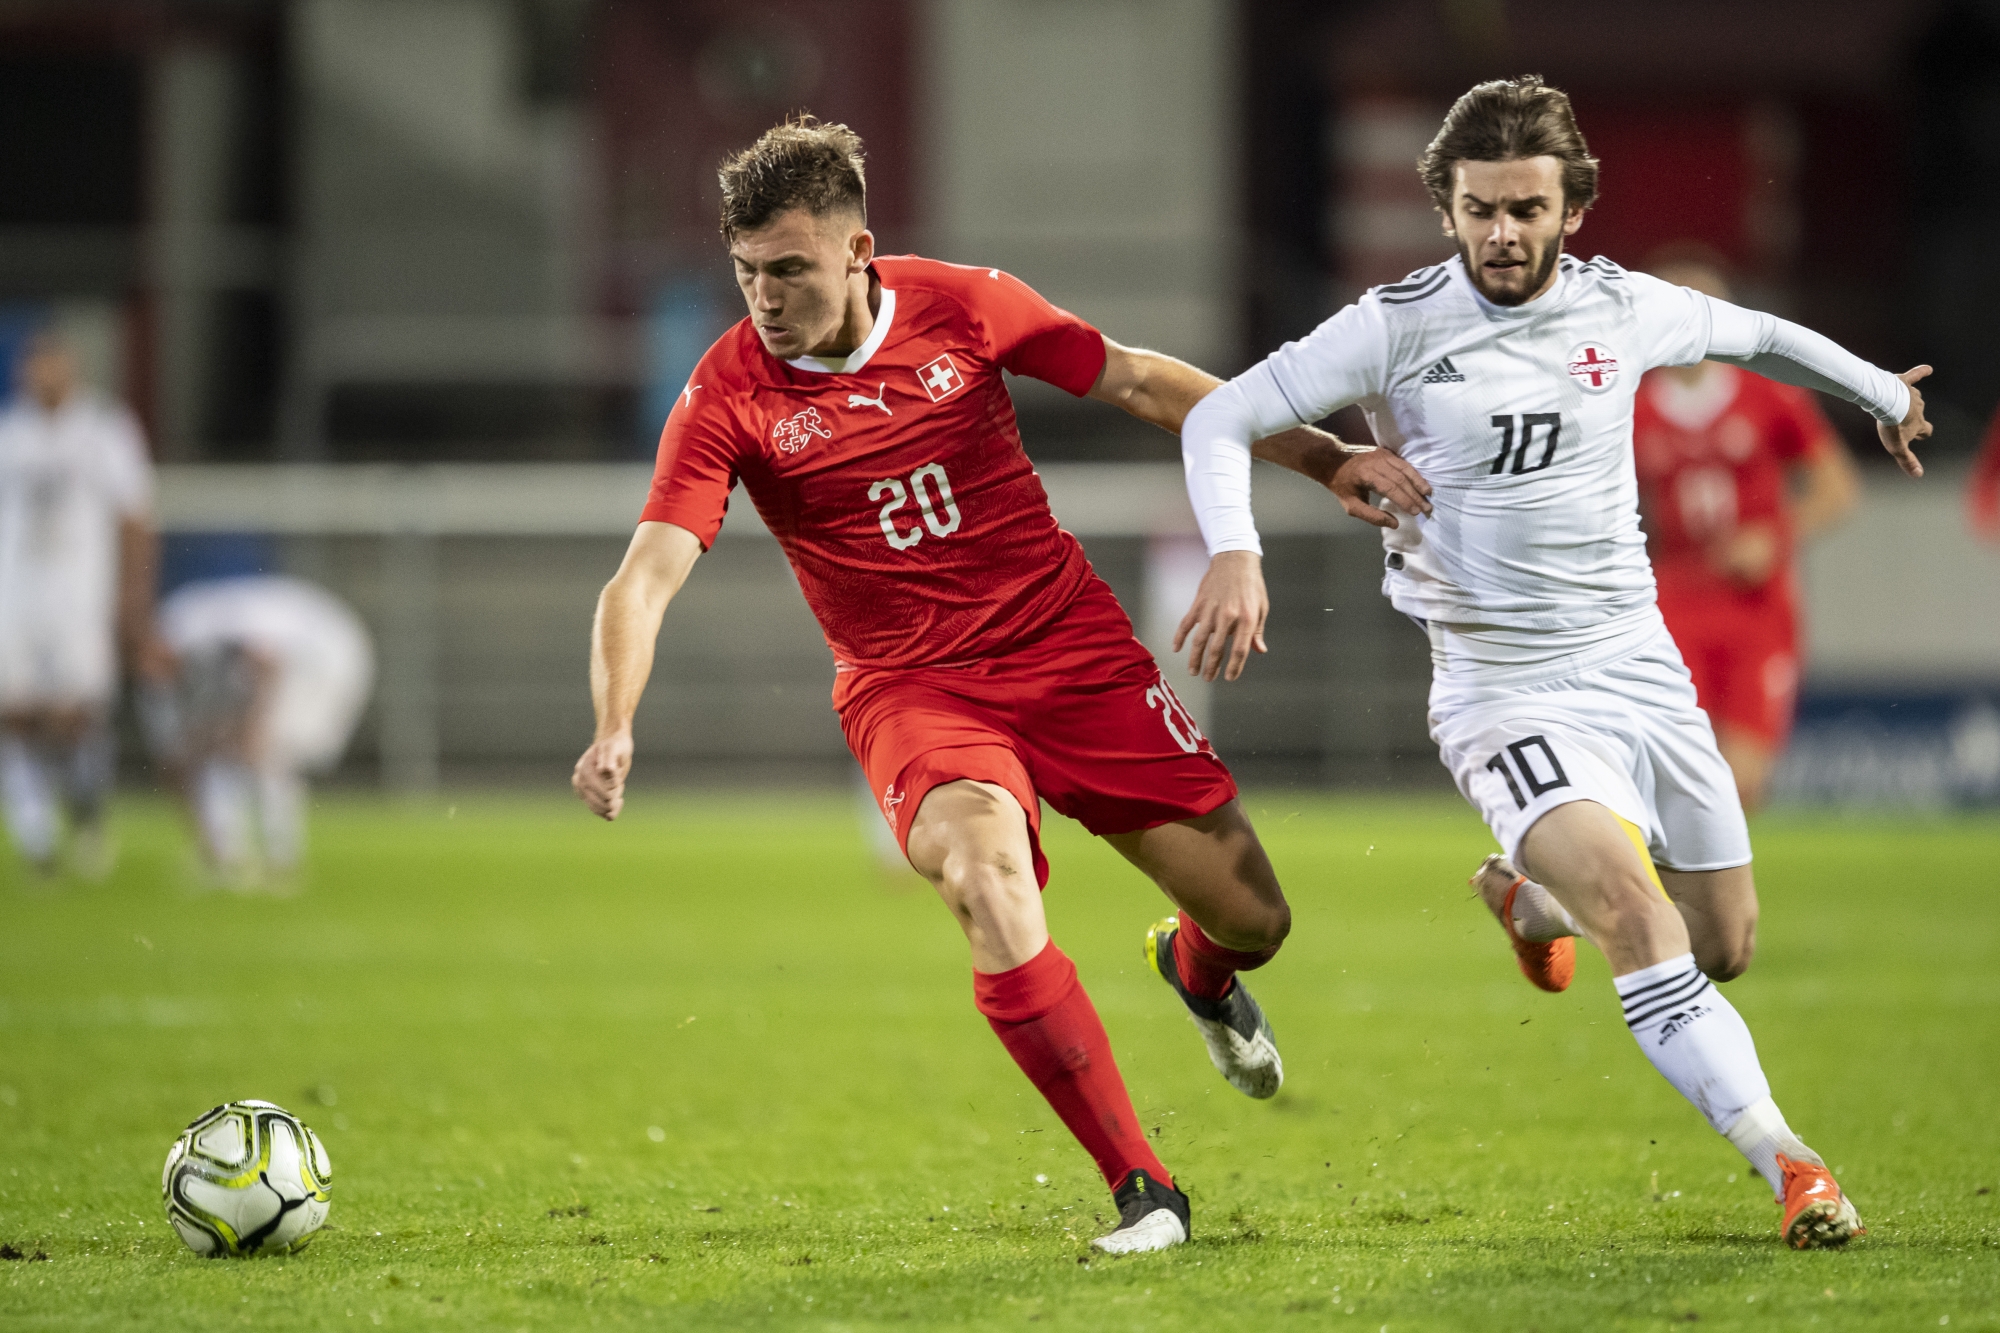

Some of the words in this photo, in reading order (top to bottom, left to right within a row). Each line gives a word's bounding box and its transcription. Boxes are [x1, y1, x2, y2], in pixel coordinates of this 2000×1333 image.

[1422, 372, 1465, 384] adidas
[1567, 359, 1619, 375] Georgia
[1490, 412, 1561, 475] 10
[867, 462, 962, 551] 20
[1146, 668, 1203, 754] 20
[1485, 734, 1572, 811] 10
